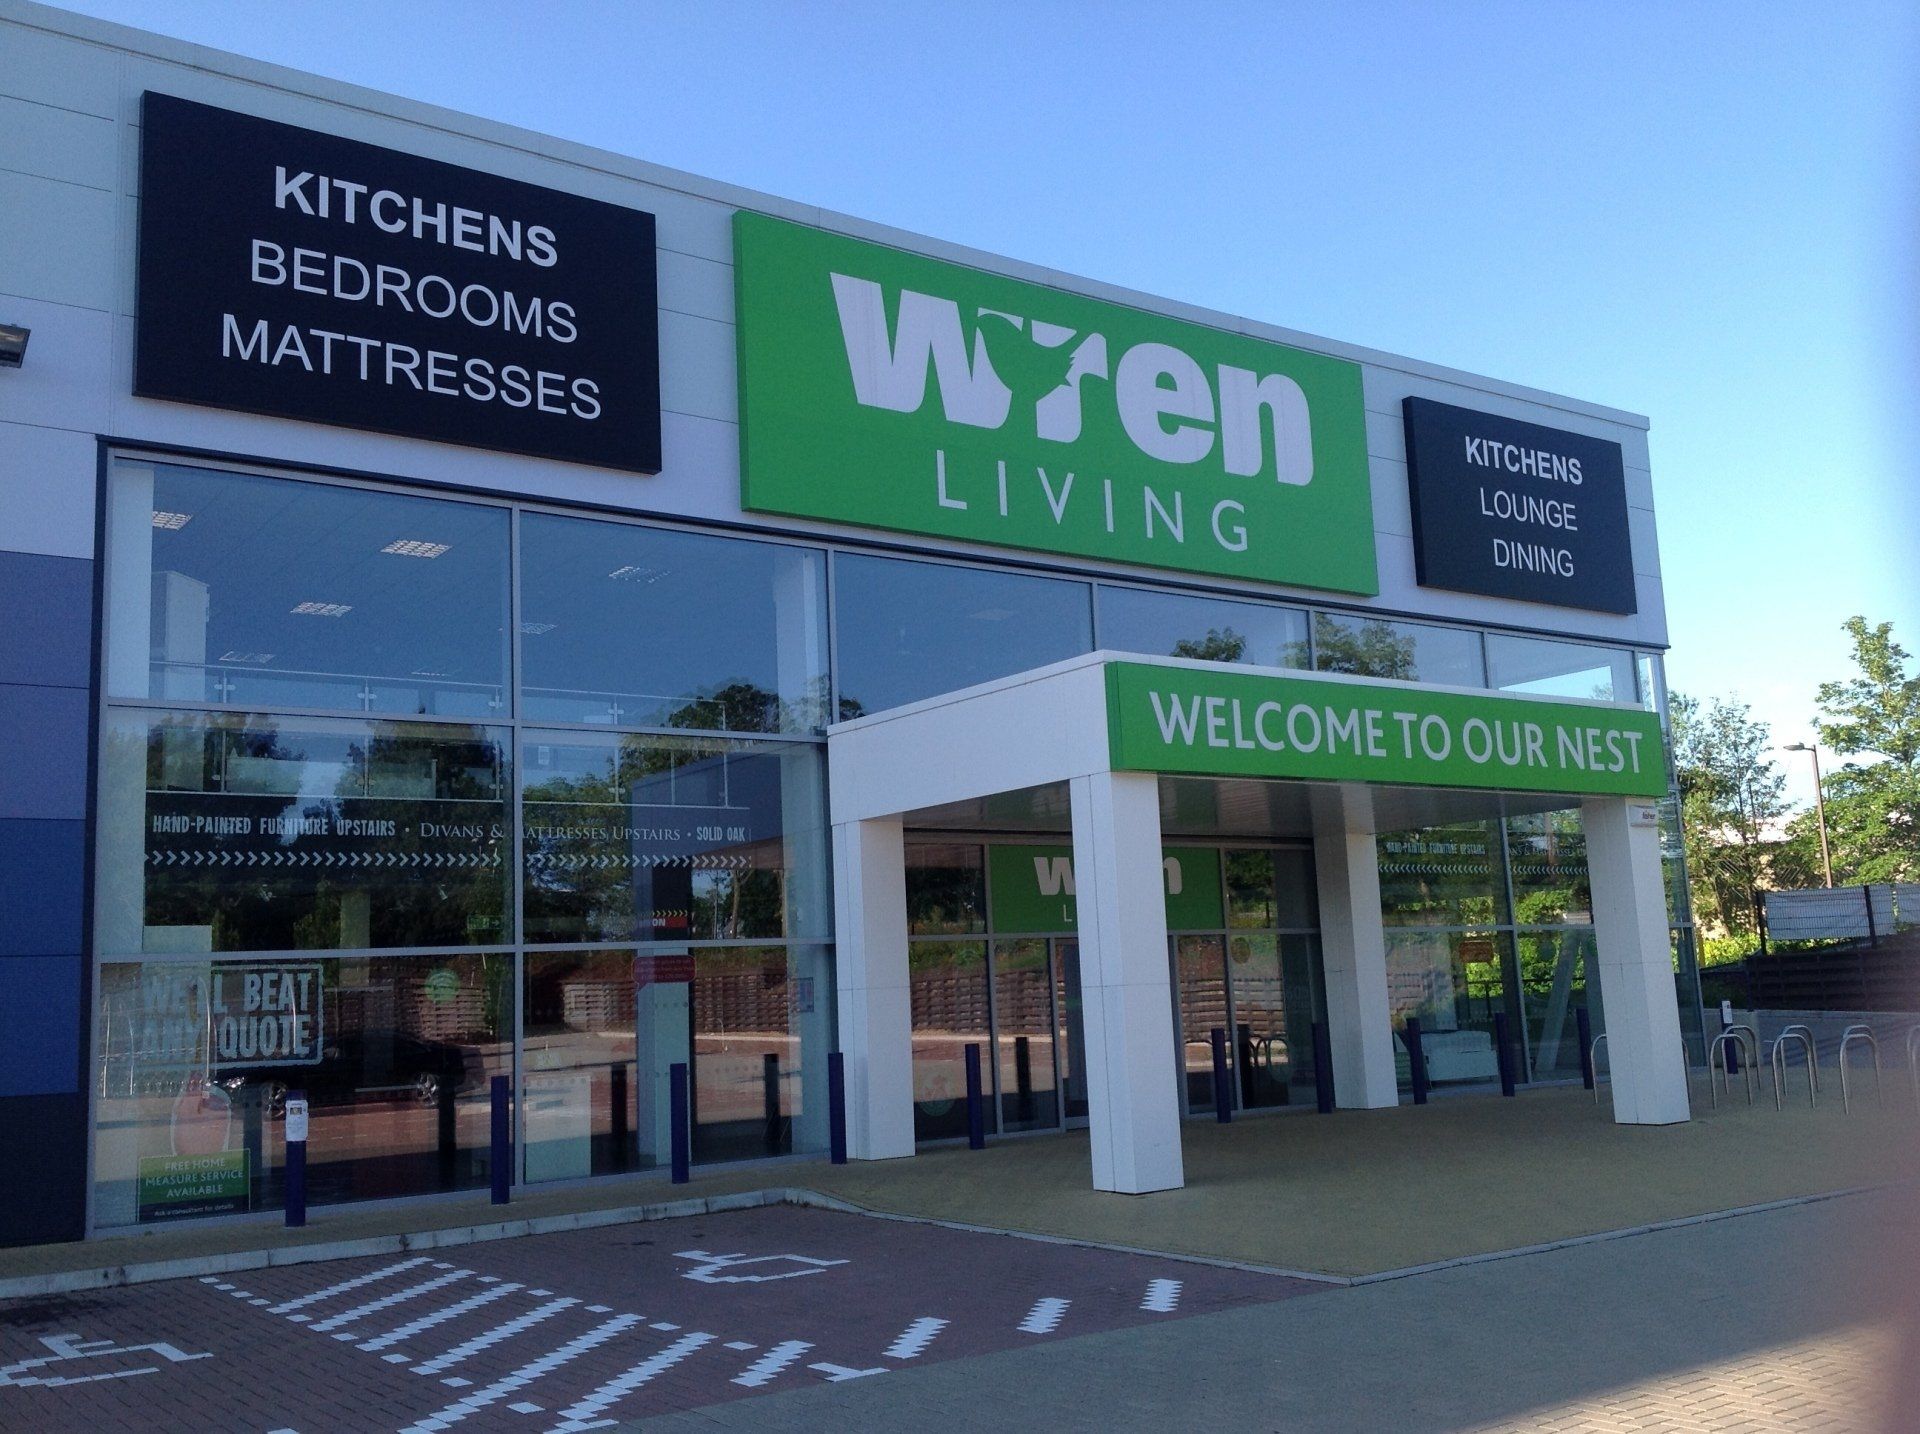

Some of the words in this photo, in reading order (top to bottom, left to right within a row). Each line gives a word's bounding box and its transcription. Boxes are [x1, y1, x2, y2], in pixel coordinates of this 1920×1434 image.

[275, 165, 558, 267] KITCHENS
[251, 239, 578, 344] BEDROOMS
[222, 313, 602, 420] MATTRESSES
[829, 271, 1315, 488] wren
[1465, 435, 1583, 485] KITCHENS
[937, 449, 1249, 553] LIVING
[1480, 487, 1578, 531] LOUNGE
[1493, 538, 1574, 577] DINING
[1149, 691, 1387, 757] WELCOME
[1393, 711, 1451, 761] TO
[1462, 718, 1548, 768] OUR
[1556, 725, 1643, 774] NEST
[153, 815, 251, 834] HAND-PAINTED
[259, 818, 329, 836] FURNITURE
[336, 820, 396, 836] UPSTAIRS
[490, 823, 504, 838] &
[696, 826, 723, 842] SOLID
[727, 827, 745, 842] OAK
[244, 972, 312, 1011] BEAT
[219, 1014, 310, 1059] QUOTE
[145, 1174, 197, 1187] MEASURE
[201, 1170, 243, 1181] SERVICE
[164, 1161, 189, 1171] FREE
[193, 1158, 225, 1170] HOME
[166, 1184, 224, 1198] AVAILABLE
